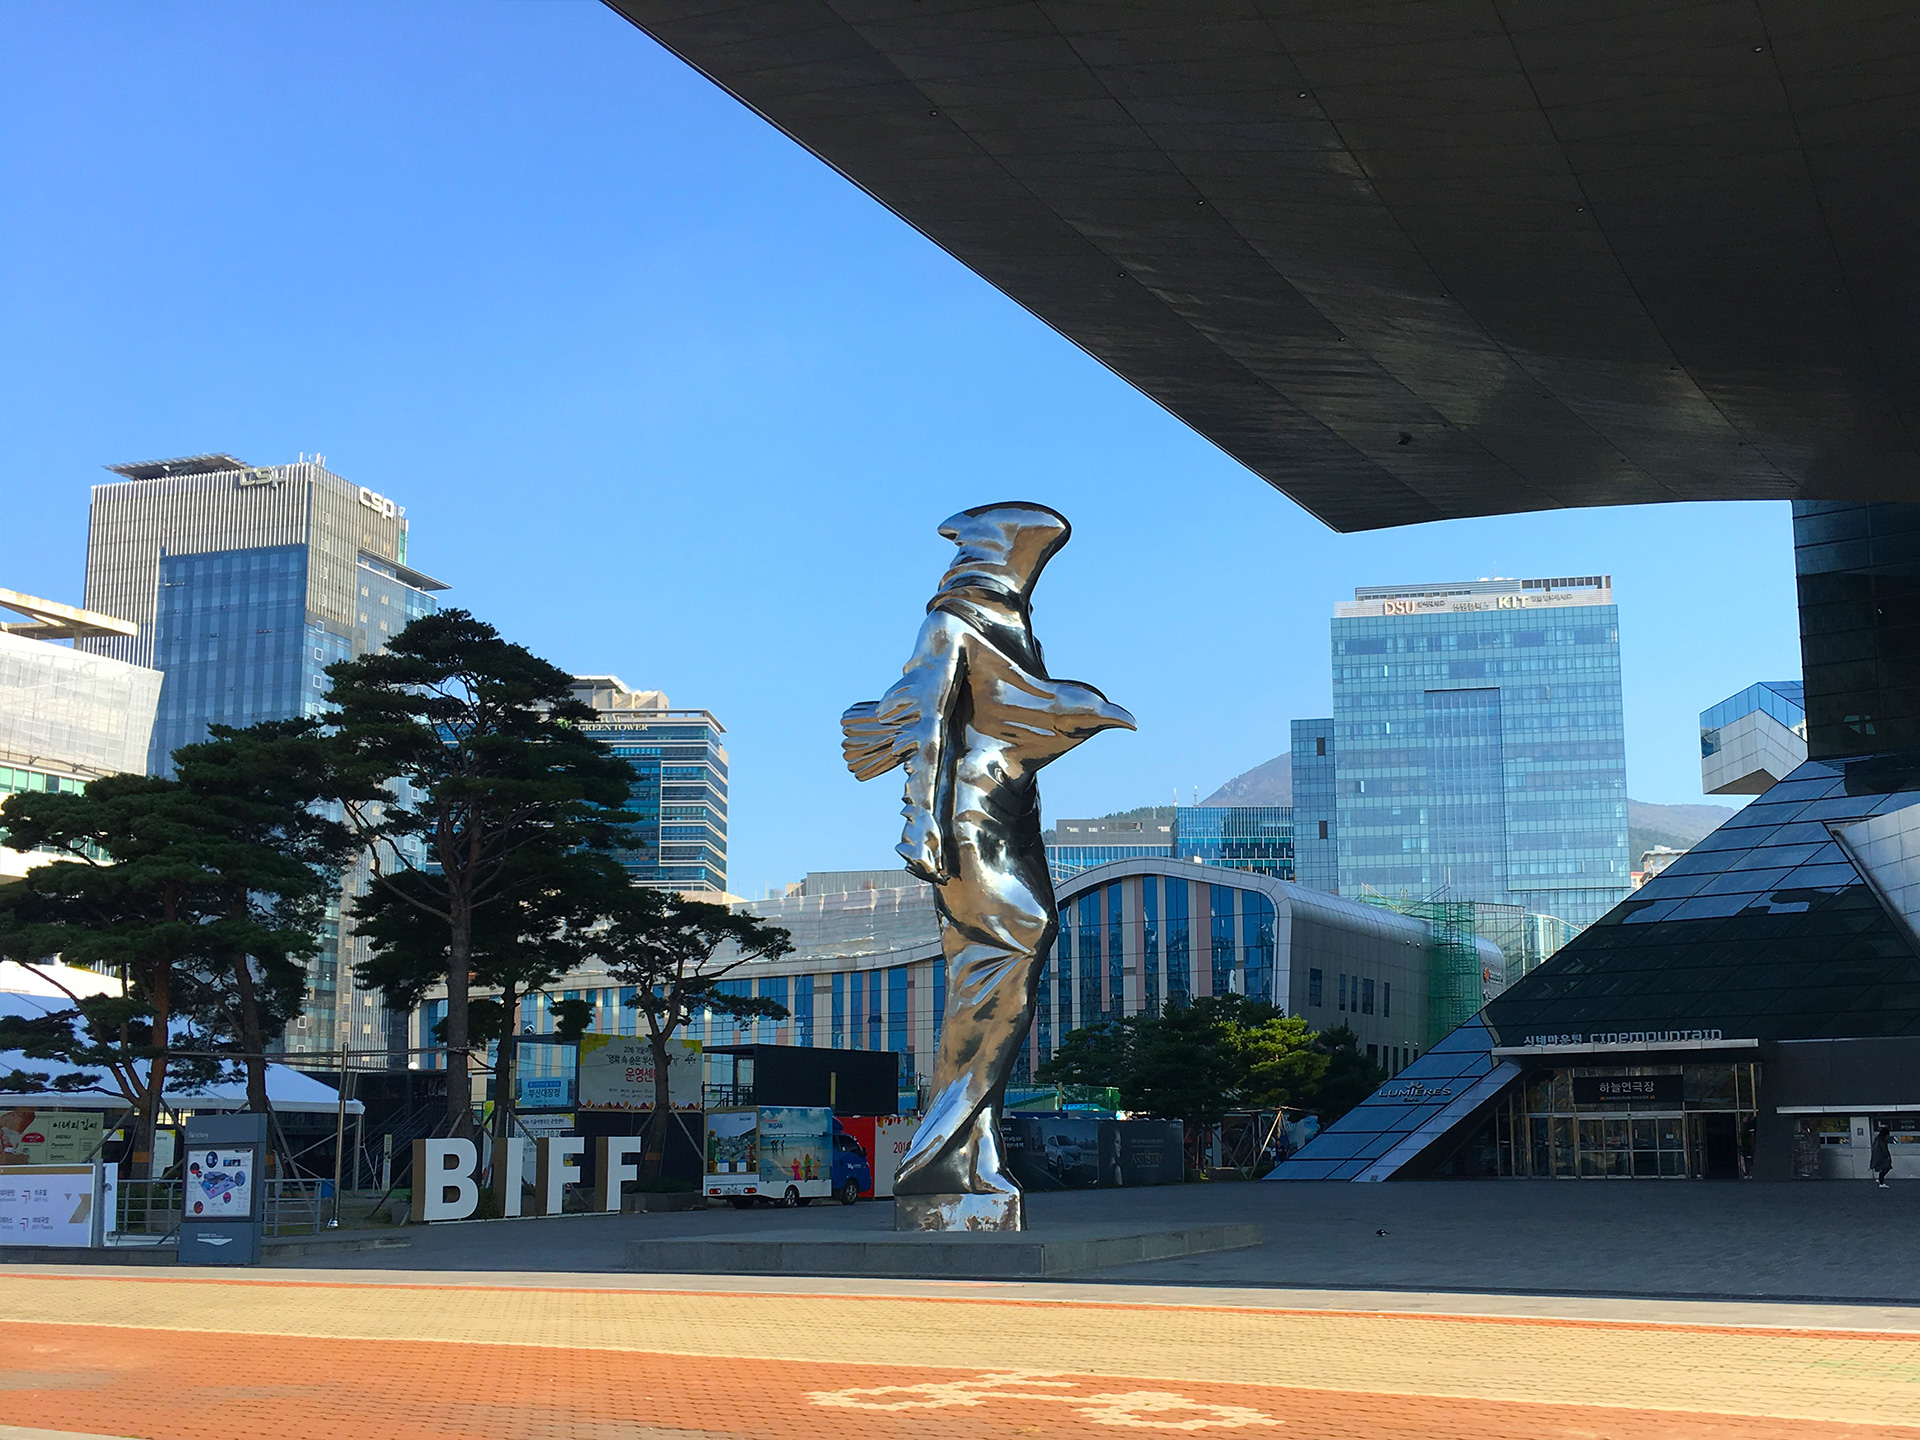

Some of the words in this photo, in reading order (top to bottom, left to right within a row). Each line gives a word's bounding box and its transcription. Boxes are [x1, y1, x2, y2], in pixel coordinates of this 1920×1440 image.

[1383, 600, 1416, 615] DSU
[1497, 596, 1528, 609] KIT
[578, 723, 611, 731] GREEN
[614, 723, 648, 731] TOWER
[625, 1067, 657, 1083] 운영센
[1600, 1081, 1655, 1094] 하늘연극장
[411, 1136, 641, 1222] BIFF
